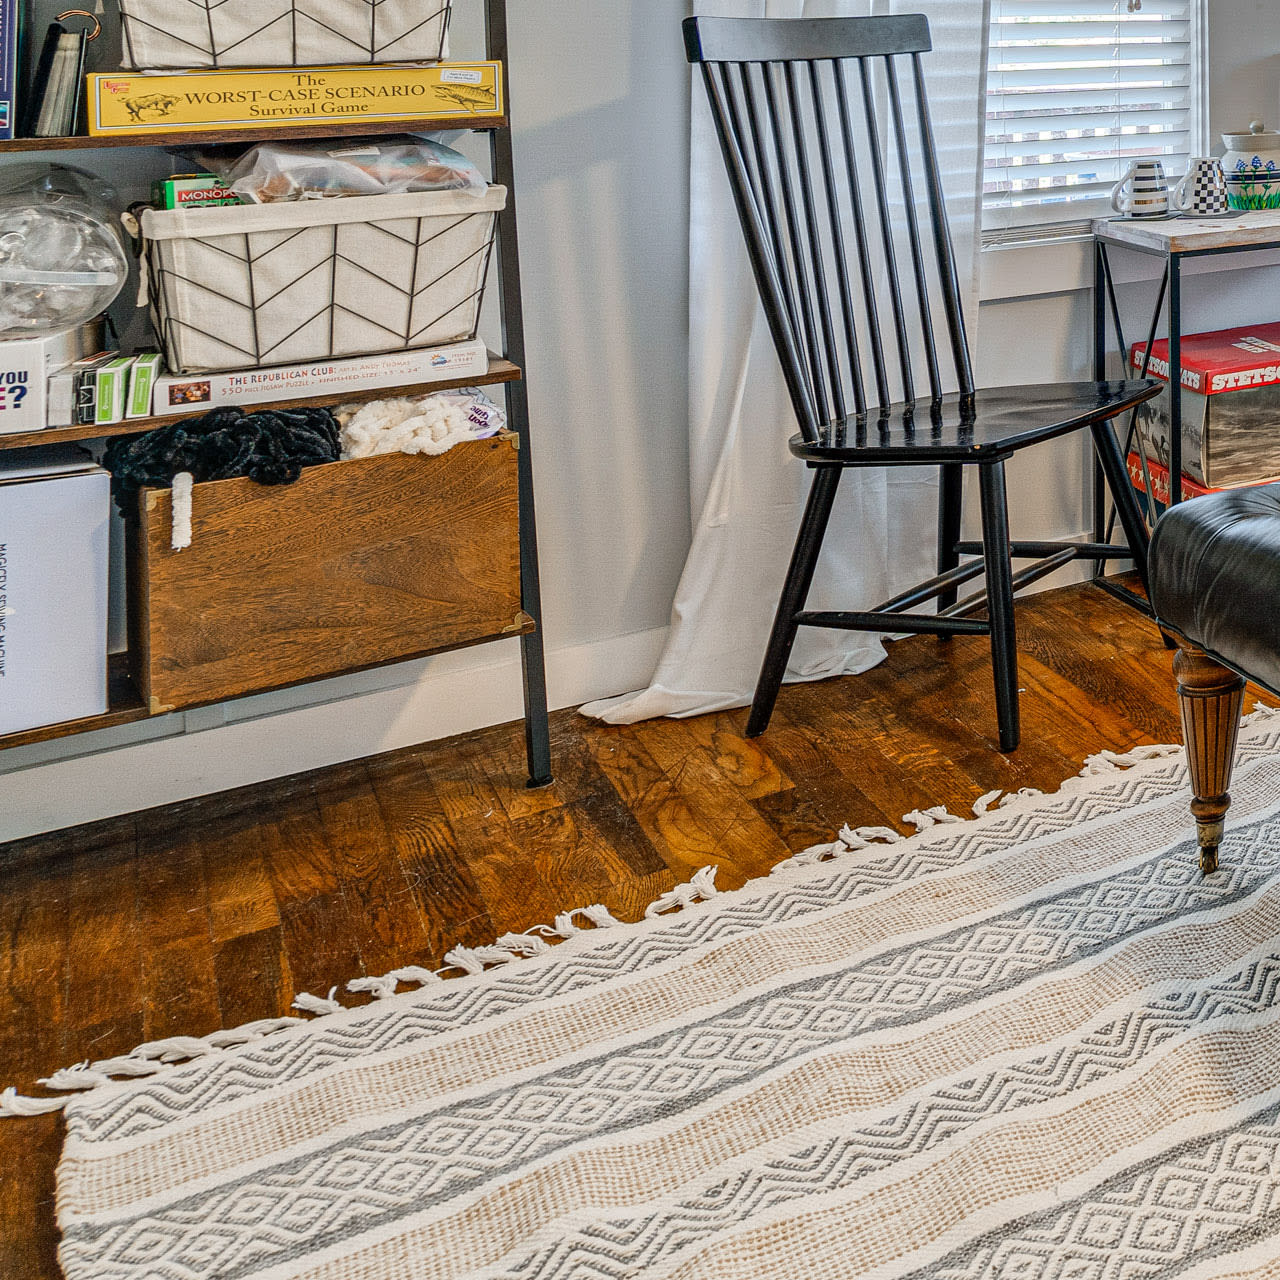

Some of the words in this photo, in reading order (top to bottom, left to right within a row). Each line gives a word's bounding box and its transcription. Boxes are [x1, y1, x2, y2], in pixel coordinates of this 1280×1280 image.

[292, 74, 326, 87] The
[185, 87, 320, 105] WORST-CASE
[324, 84, 426, 99] SCENARIO
[249, 101, 317, 117] Survival
[321, 101, 369, 114] Game
[181, 189, 240, 201] MONOP
[229, 376, 248, 386] THE
[250, 369, 308, 384] REPUBLICAN
[311, 366, 337, 377] CLUB:
[1134, 350, 1170, 378] STTSON
[1180, 367, 1201, 390] ATS
